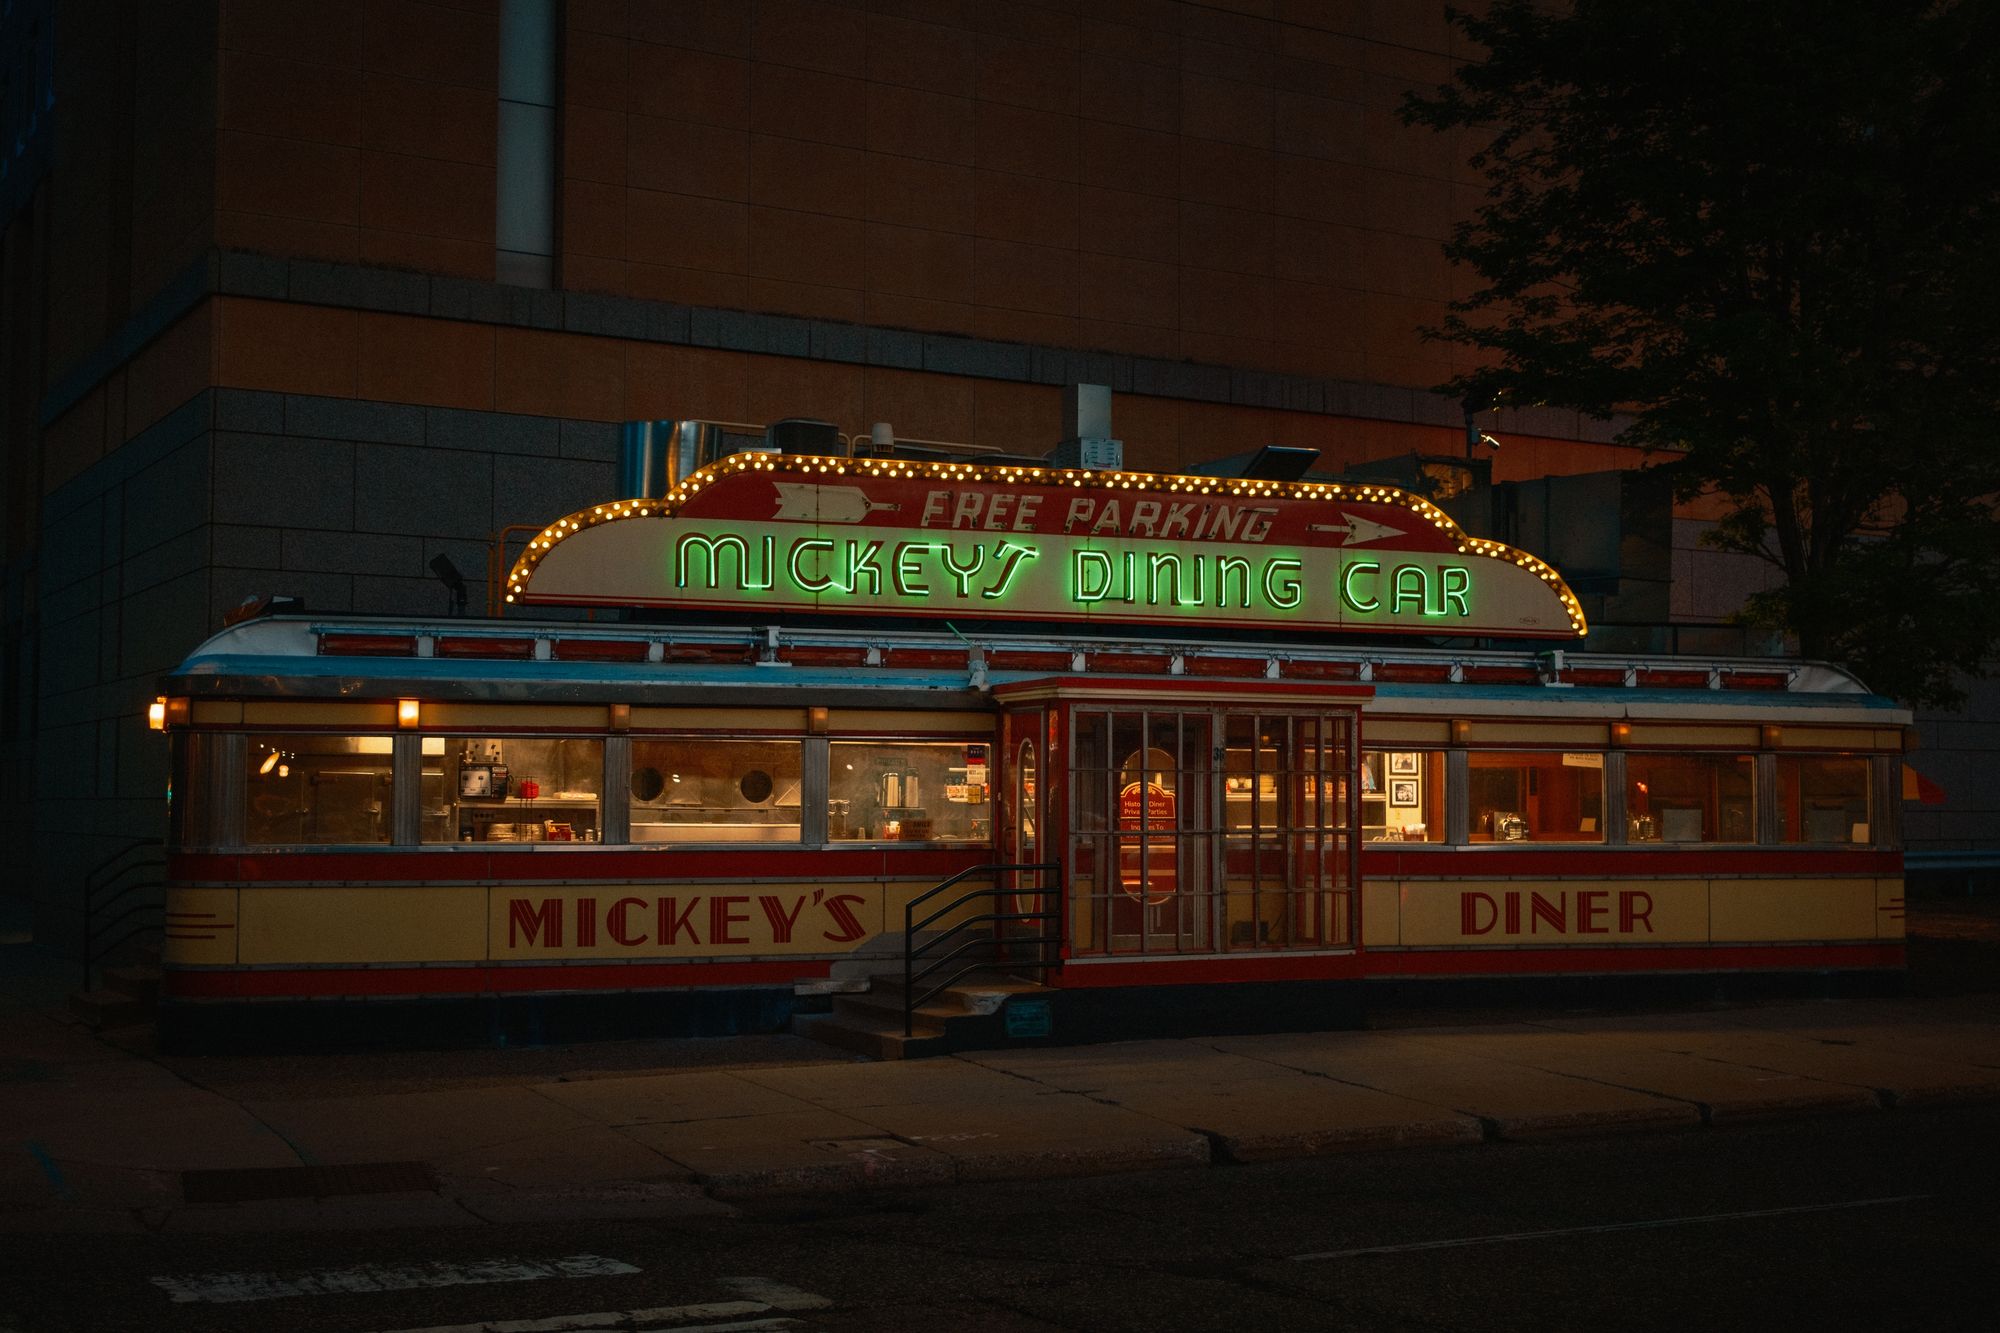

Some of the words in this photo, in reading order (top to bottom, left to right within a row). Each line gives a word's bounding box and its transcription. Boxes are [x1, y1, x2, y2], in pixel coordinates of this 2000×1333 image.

[920, 490, 1043, 532] FREE
[1065, 497, 1279, 543] PARKING
[675, 531, 1040, 599] MICKEY'S
[1073, 549, 1302, 609] DINING
[1341, 560, 1472, 617] CAR
[509, 888, 866, 949] MICKEY'S
[1461, 890, 1654, 935] DINER
